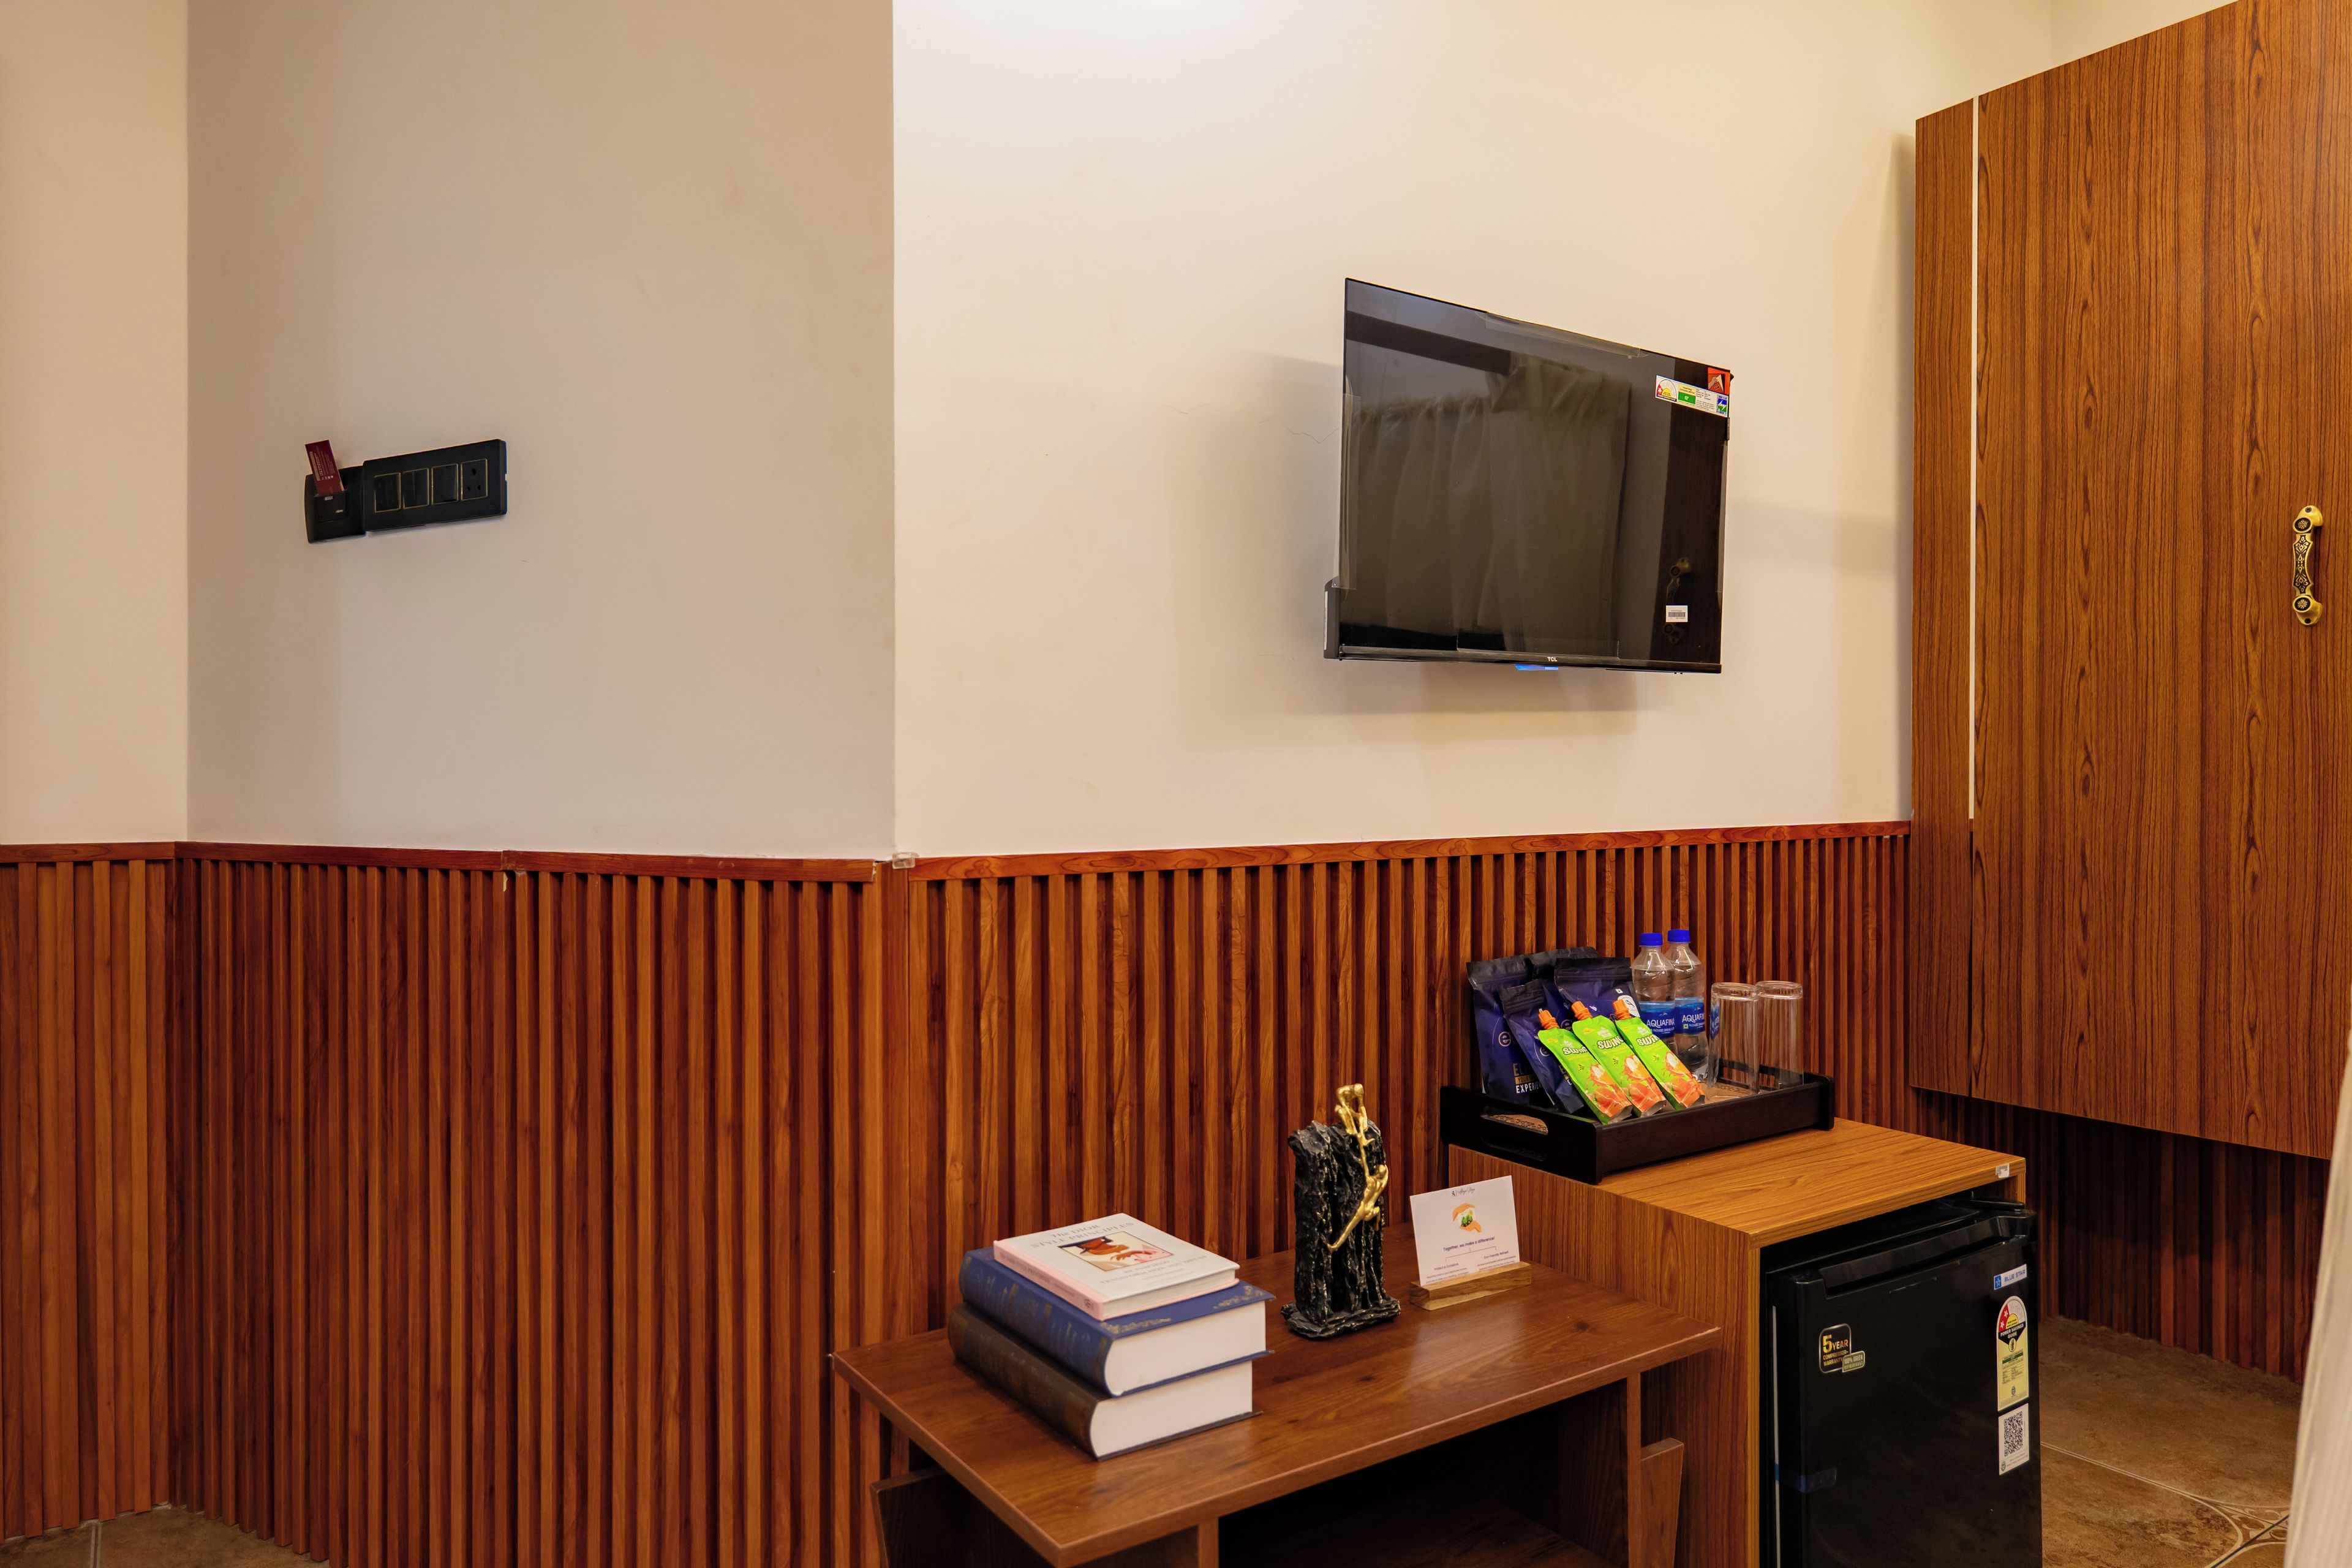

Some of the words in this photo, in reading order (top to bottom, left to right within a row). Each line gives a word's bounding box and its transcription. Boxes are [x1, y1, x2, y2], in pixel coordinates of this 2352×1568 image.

[1646, 1018, 1675, 1028] AQUAFINA
[1031, 1238, 1065, 1248] STYLE
[1069, 1223, 1134, 1240] PRINCIPLES
[1071, 1225, 1100, 1234] DIOR
[2004, 1273, 2015, 1282] BLUE
[2015, 1269, 2026, 1278] STAR
[1823, 1335, 1832, 1353] 5
[1832, 1340, 1849, 1351] YEAR
